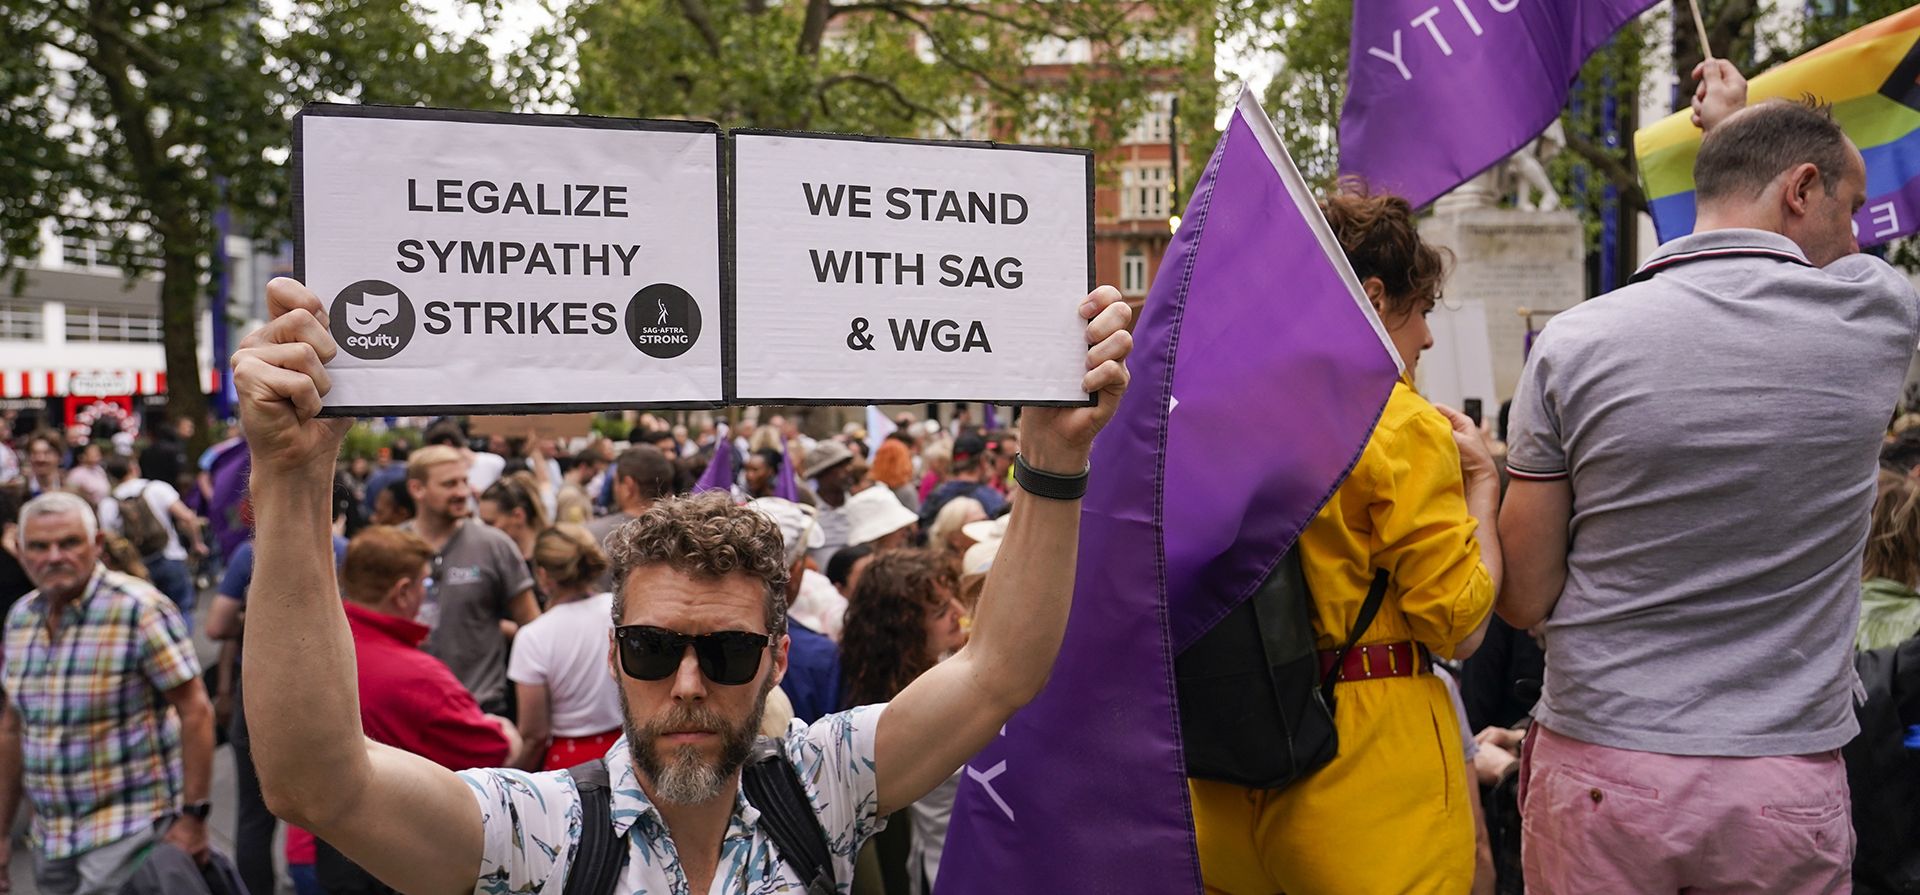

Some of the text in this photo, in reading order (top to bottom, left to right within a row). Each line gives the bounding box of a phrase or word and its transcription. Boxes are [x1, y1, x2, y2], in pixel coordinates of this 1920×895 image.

[407, 178, 629, 218] LEGALIZE
[801, 182, 1029, 225] WE STAND
[396, 239, 641, 276] SYMPATHY
[808, 249, 1024, 290] WITH SAG
[423, 300, 618, 335] STRIKES
[846, 317, 993, 353] & WGA
[346, 333, 400, 349] equity
[639, 334, 689, 344] STRONG
